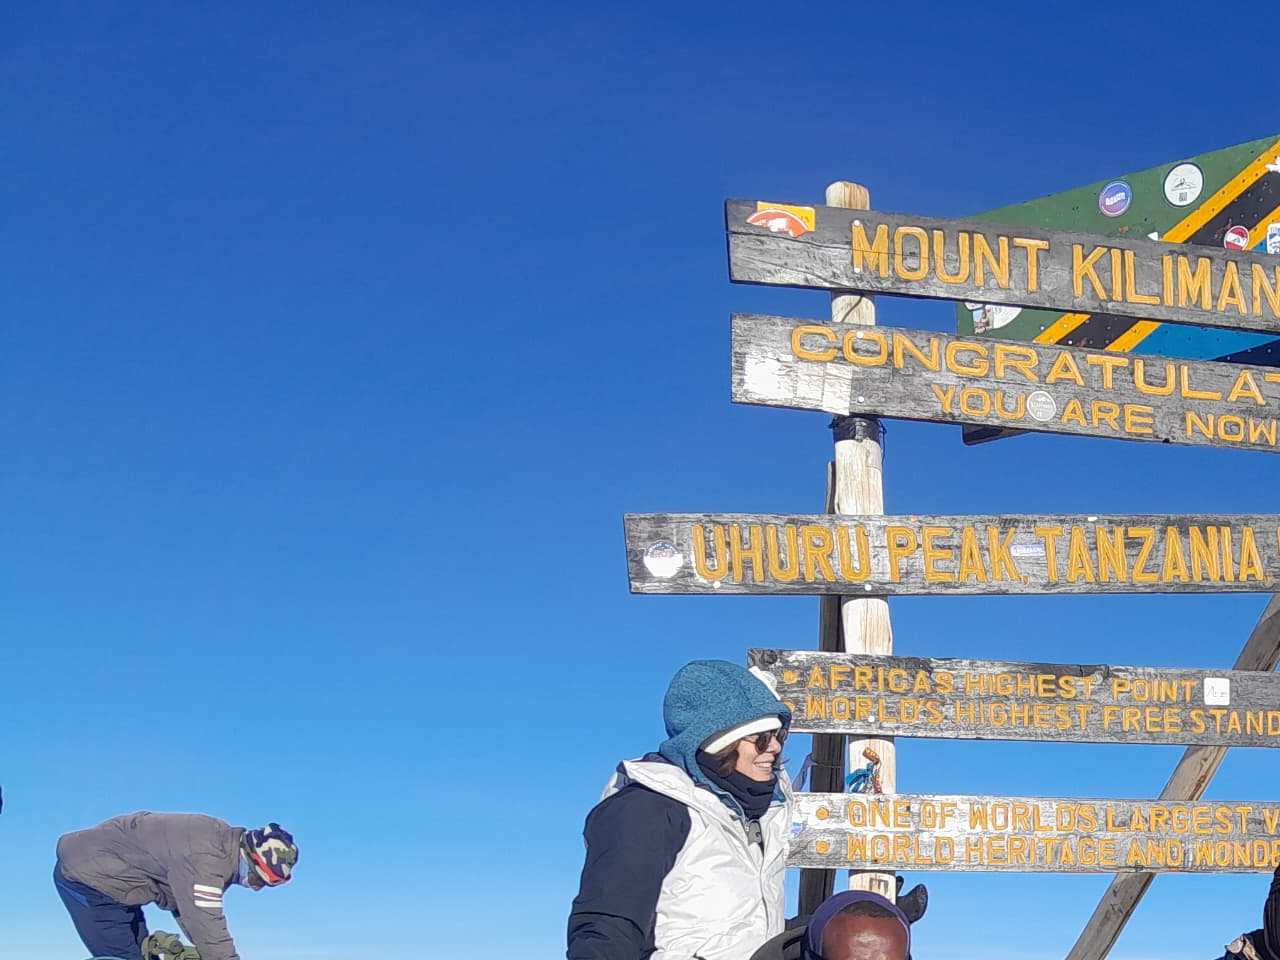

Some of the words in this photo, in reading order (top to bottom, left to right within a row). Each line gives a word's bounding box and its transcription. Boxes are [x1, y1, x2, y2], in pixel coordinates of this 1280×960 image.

[851, 224, 1049, 292] MOUNT
[932, 384, 1026, 420] YOU
[1060, 400, 1154, 434] ARE
[1185, 411, 1277, 446] NOW
[692, 525, 872, 582] UHURU
[965, 672, 1096, 699] HIGHEST
[1111, 677, 1197, 703] POINT
[805, 694, 944, 724] WORLD'S
[955, 700, 1092, 730] HIGHEST
[1102, 705, 1182, 733] FREE
[848, 800, 911, 828] ONE
[921, 802, 957, 828] OF
[1106, 805, 1252, 835] LARGEST
[848, 834, 955, 863] WORLD
[965, 836, 1117, 866] HERITAGE
[1126, 838, 1183, 867] AND
